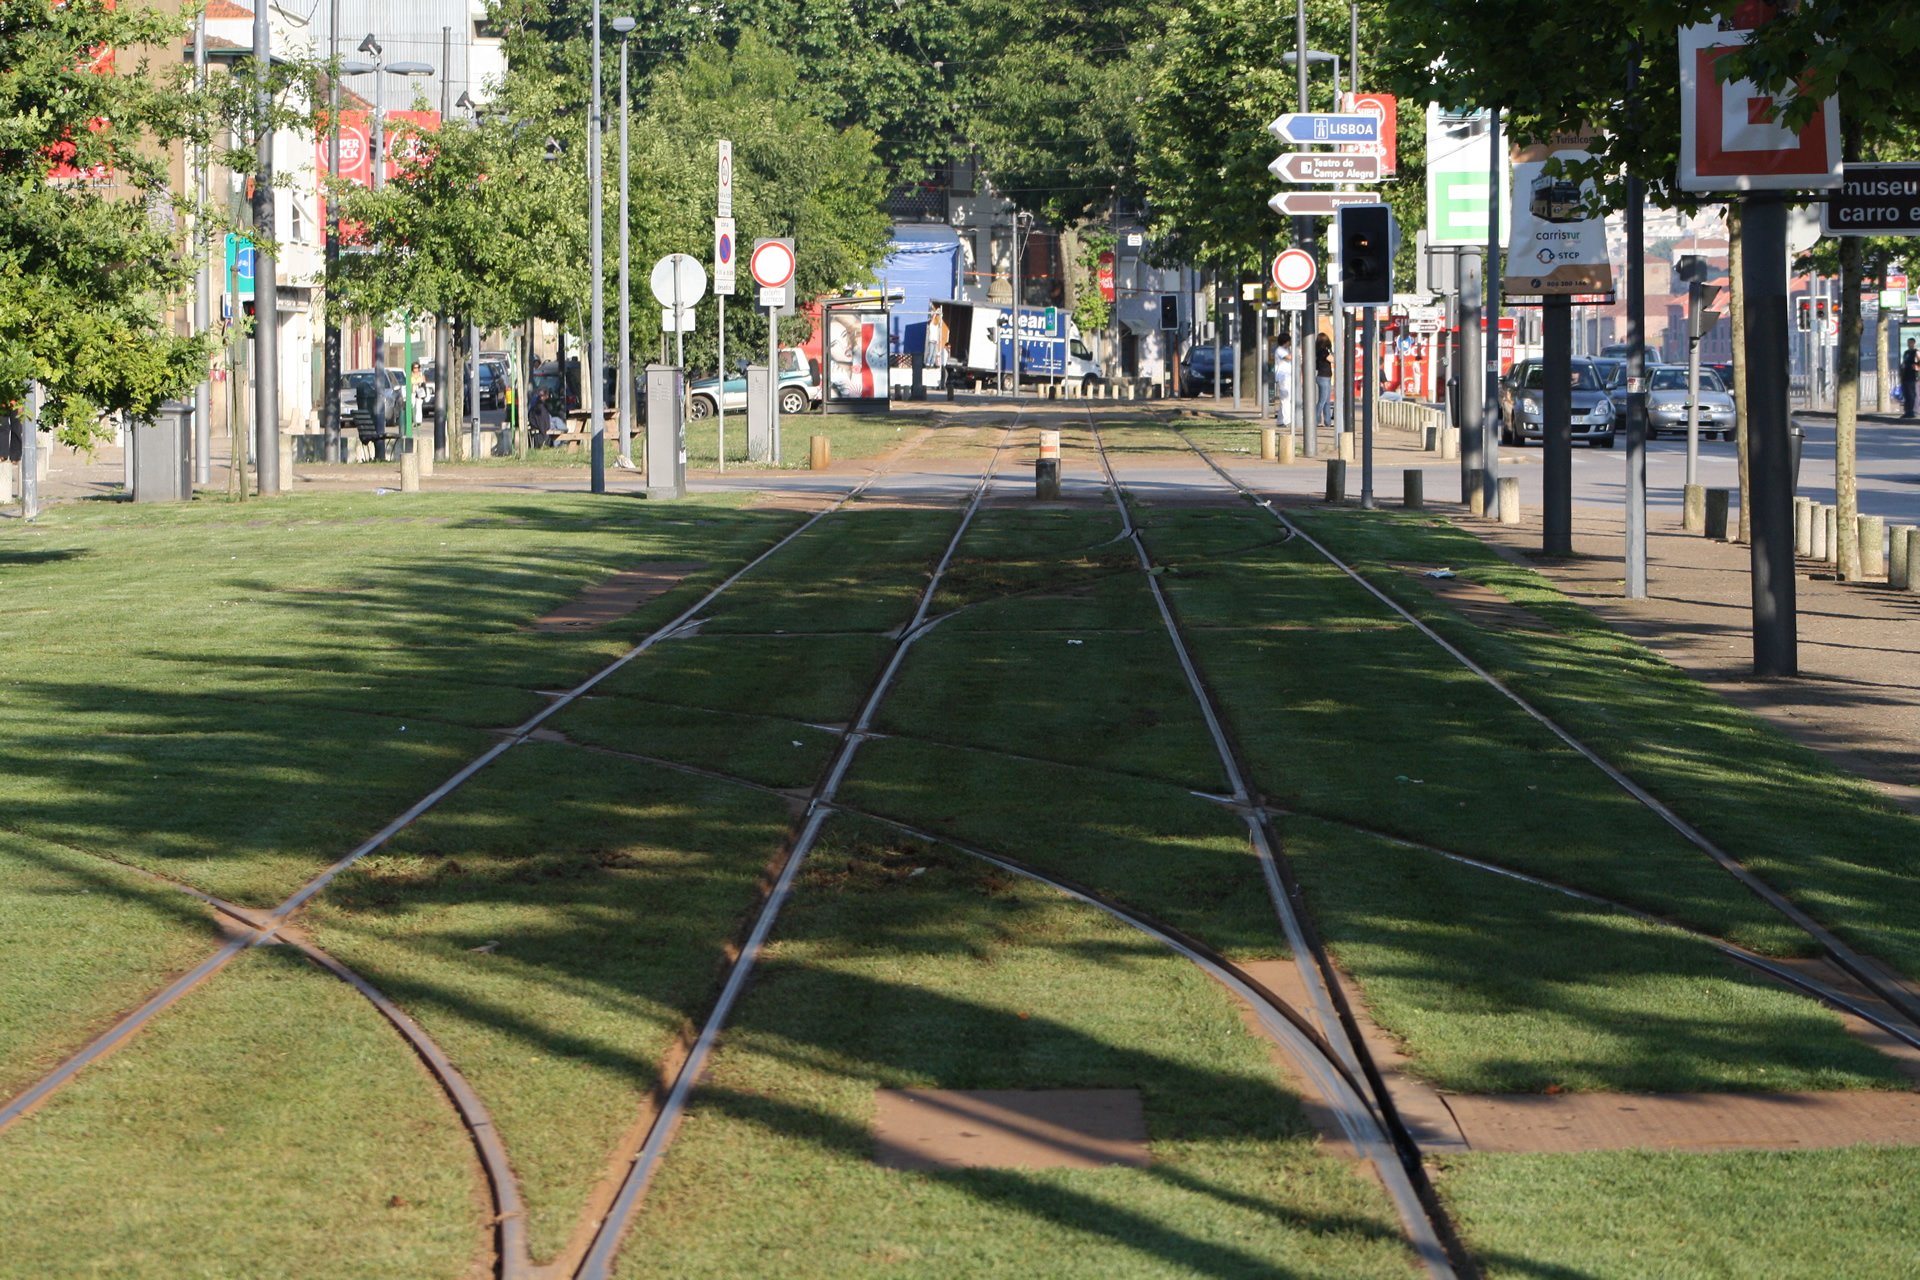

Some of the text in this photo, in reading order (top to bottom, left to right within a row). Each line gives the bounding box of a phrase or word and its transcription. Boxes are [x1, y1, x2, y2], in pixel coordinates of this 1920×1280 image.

[1330, 124, 1374, 135] LISBOA
[1313, 158, 1354, 168] Teatro do
[1313, 168, 1375, 180] Campo Alegre
[1841, 180, 1918, 196] museu
[1839, 206, 1900, 222] carro
[1558, 251, 1580, 260] STCP
